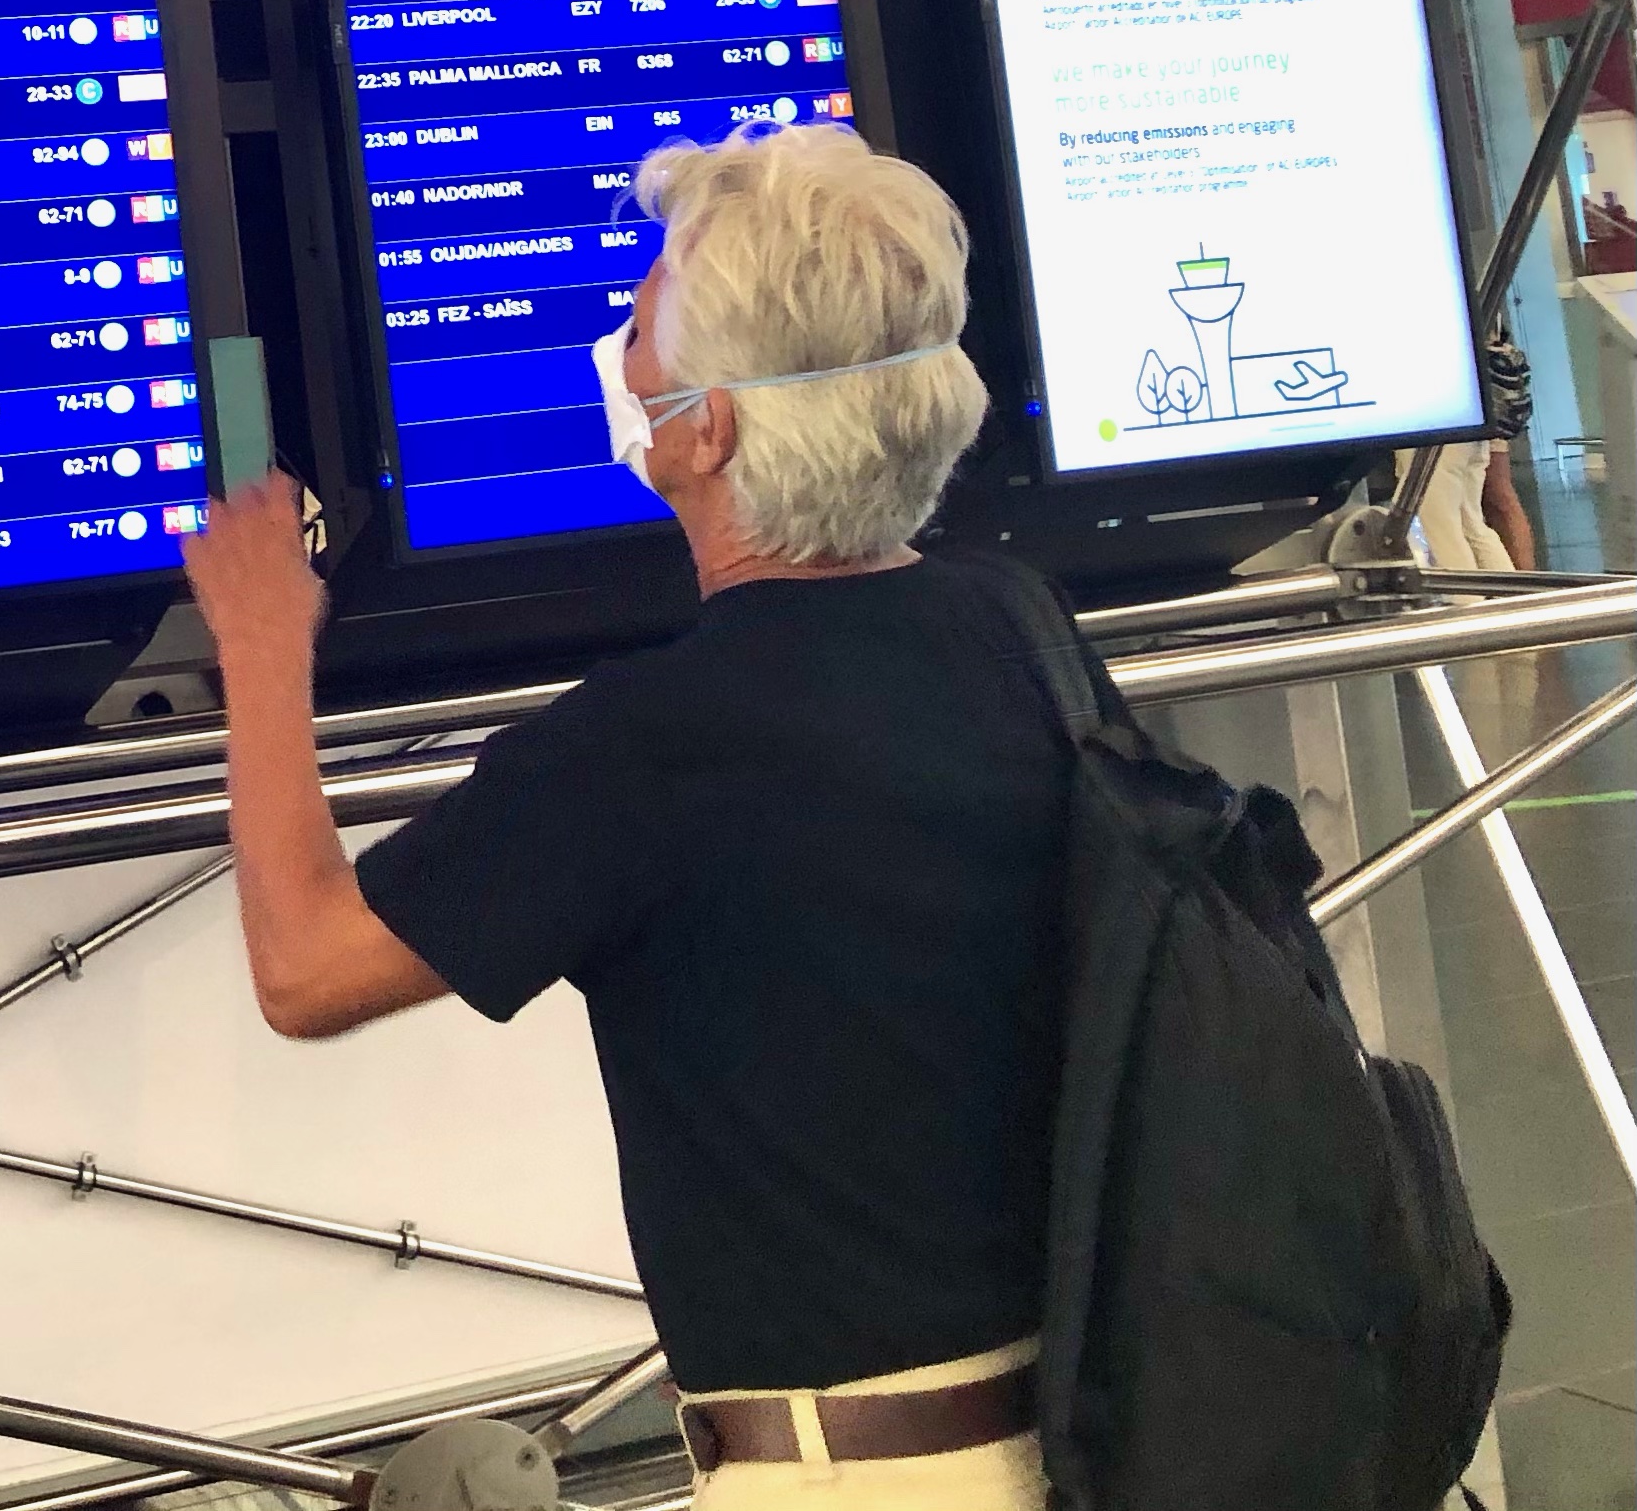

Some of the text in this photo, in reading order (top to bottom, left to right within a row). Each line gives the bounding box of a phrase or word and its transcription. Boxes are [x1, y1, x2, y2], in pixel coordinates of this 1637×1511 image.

[350, 7, 497, 31] 22:20 LIVERPOOL
[357, 47, 762, 90] 22:35 PALMA MALLORCA 62-71
[364, 125, 479, 149] 23:00 DUBLIN
[1060, 133, 1076, 149] By
[1081, 131, 1140, 144] reducing
[1144, 126, 1208, 140] emissions
[371, 172, 631, 208] 01:40 NADOR/NDR MAC
[378, 230, 639, 267] 01:55 OUJDA/ANGADES MAC
[385, 308, 431, 328] 03:25
[437, 305, 472, 323] FEZ
[56, 391, 104, 412] 74-75
